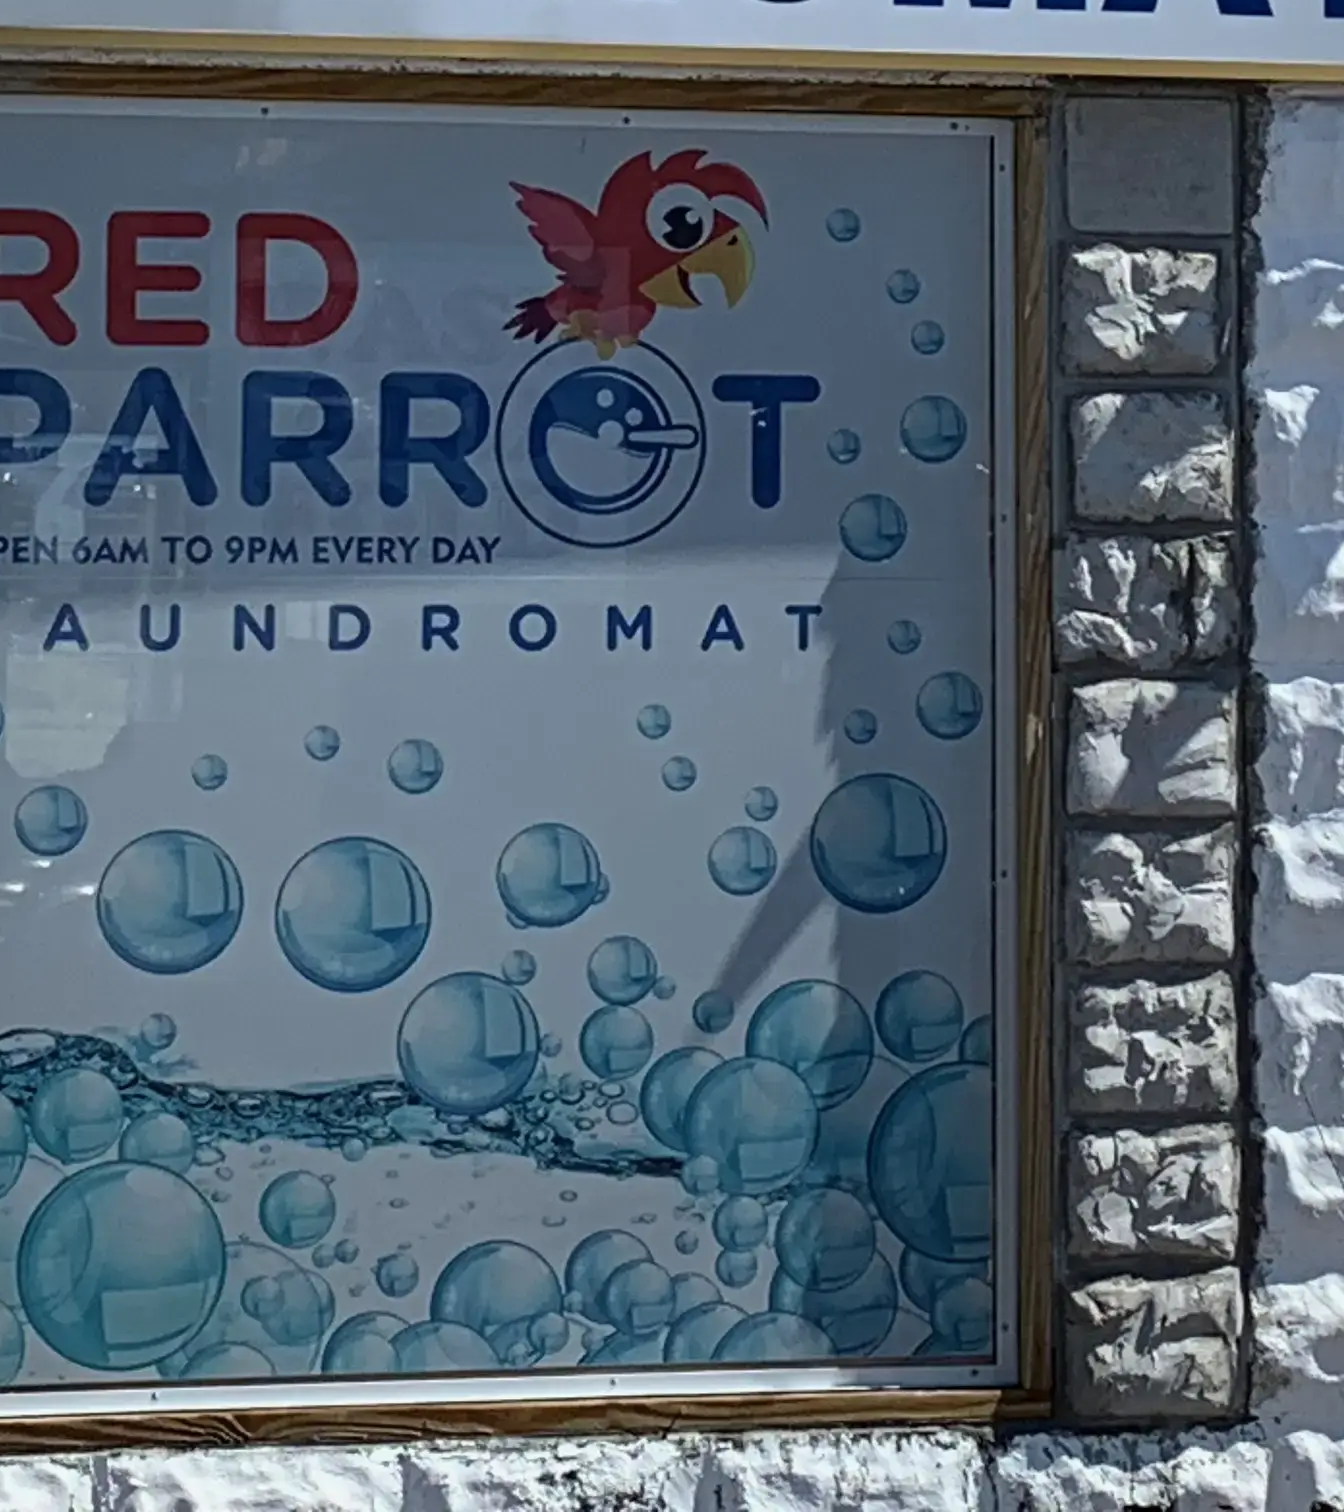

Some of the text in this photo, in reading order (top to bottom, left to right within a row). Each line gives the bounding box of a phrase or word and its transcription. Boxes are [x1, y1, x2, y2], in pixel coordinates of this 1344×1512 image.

[72, 535, 149, 564] 6AM
[161, 535, 214, 565] TO
[225, 535, 300, 565] 9PM
[312, 535, 421, 565] EVERY
[431, 535, 502, 565] DAY
